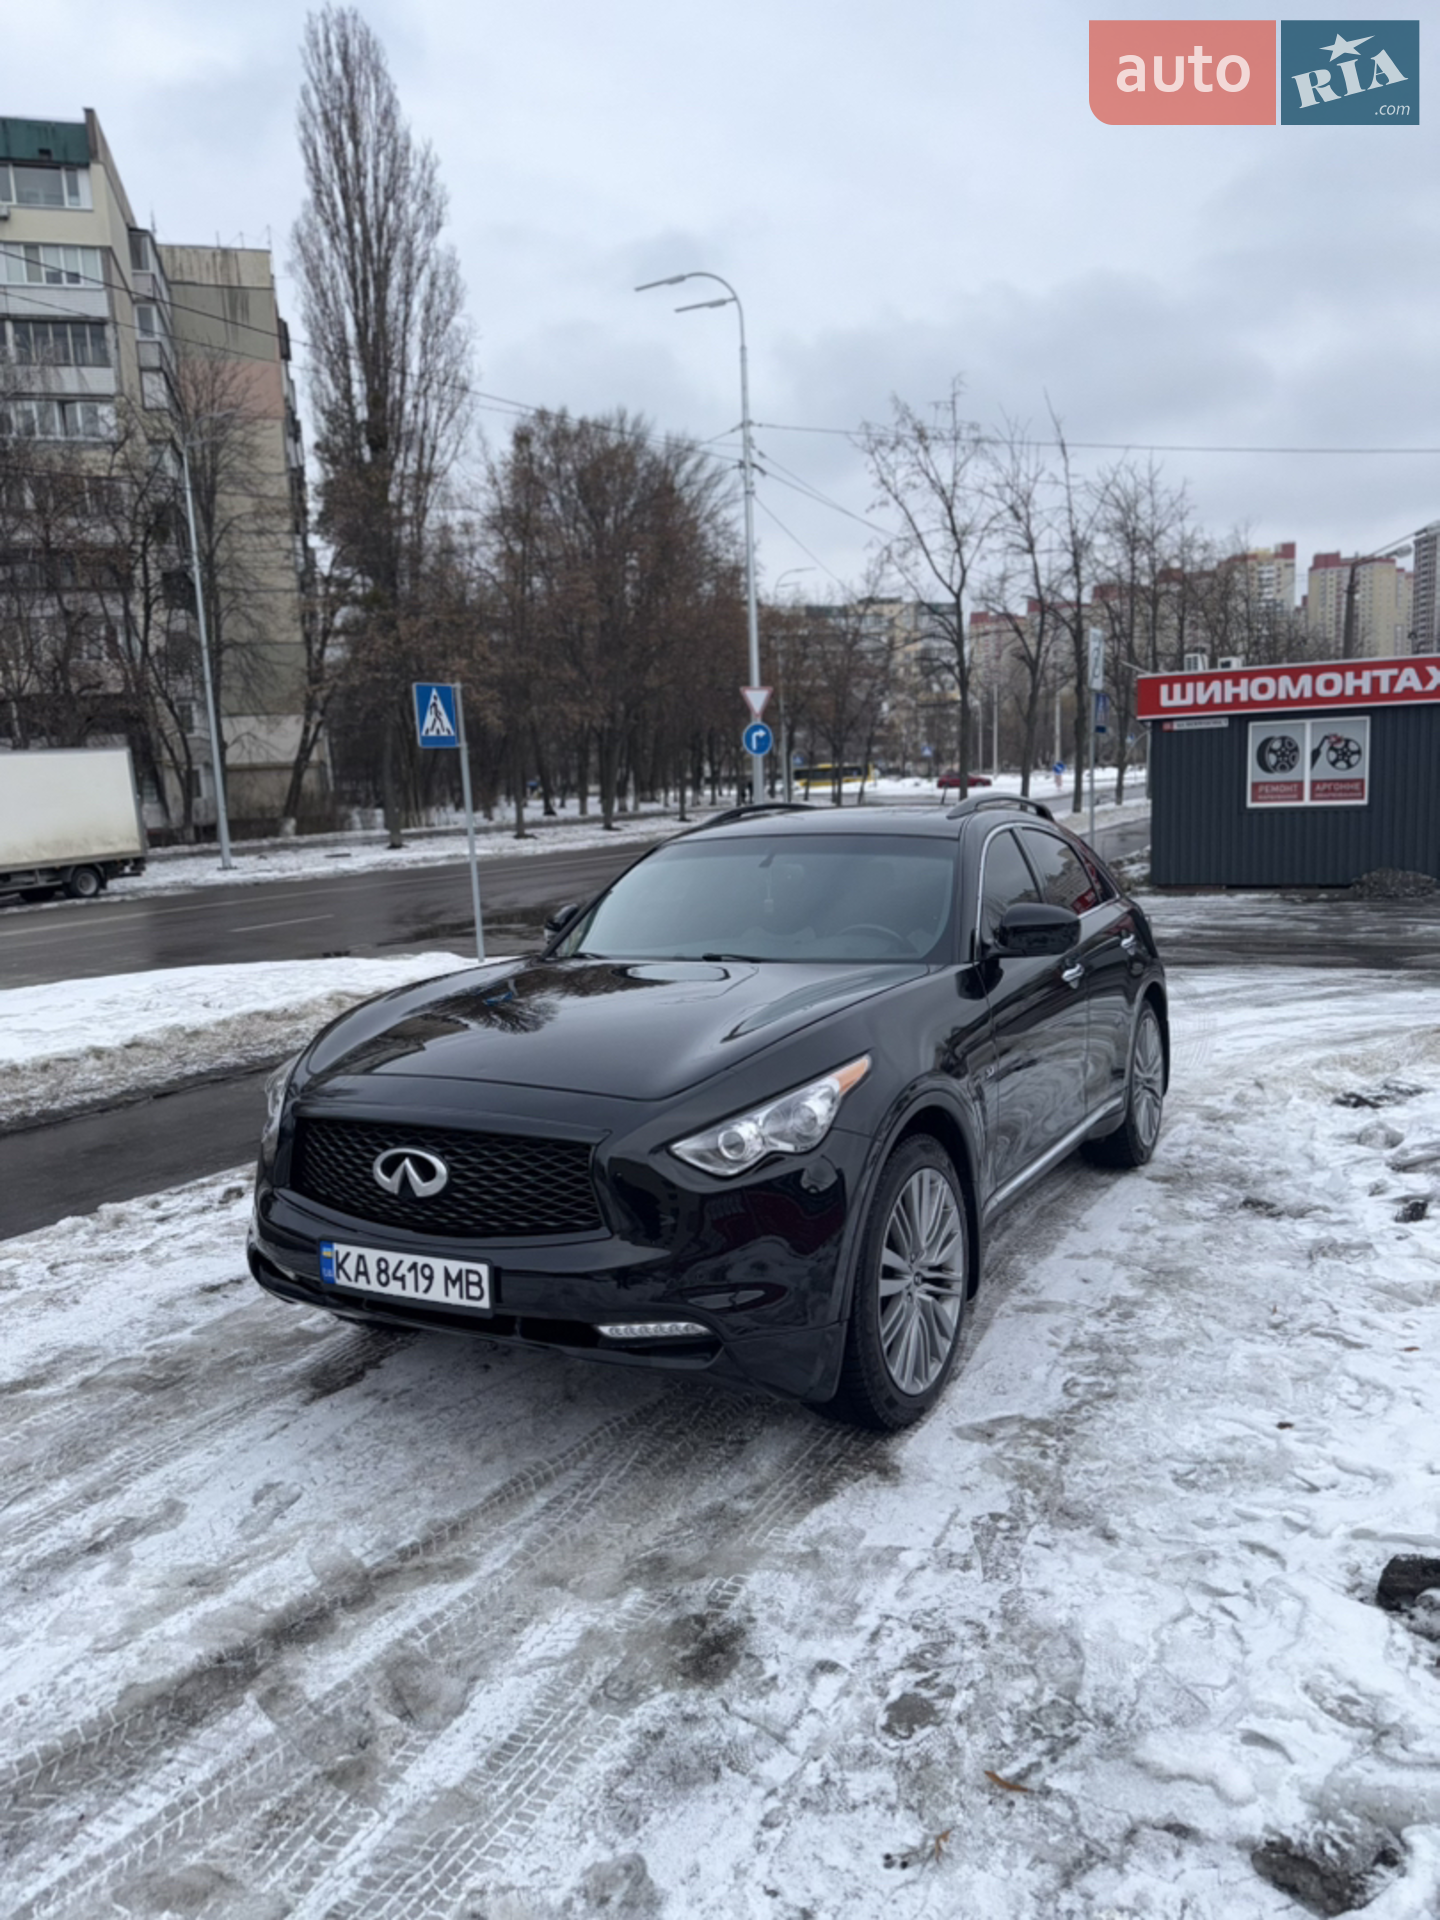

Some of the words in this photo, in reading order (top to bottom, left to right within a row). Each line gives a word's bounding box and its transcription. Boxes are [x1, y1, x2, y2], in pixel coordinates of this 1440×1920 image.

[1258, 783, 1299, 794] РЕМОНТ
[335, 1250, 371, 1286] KA
[376, 1257, 435, 1295] 8419
[444, 1266, 485, 1302] MB
